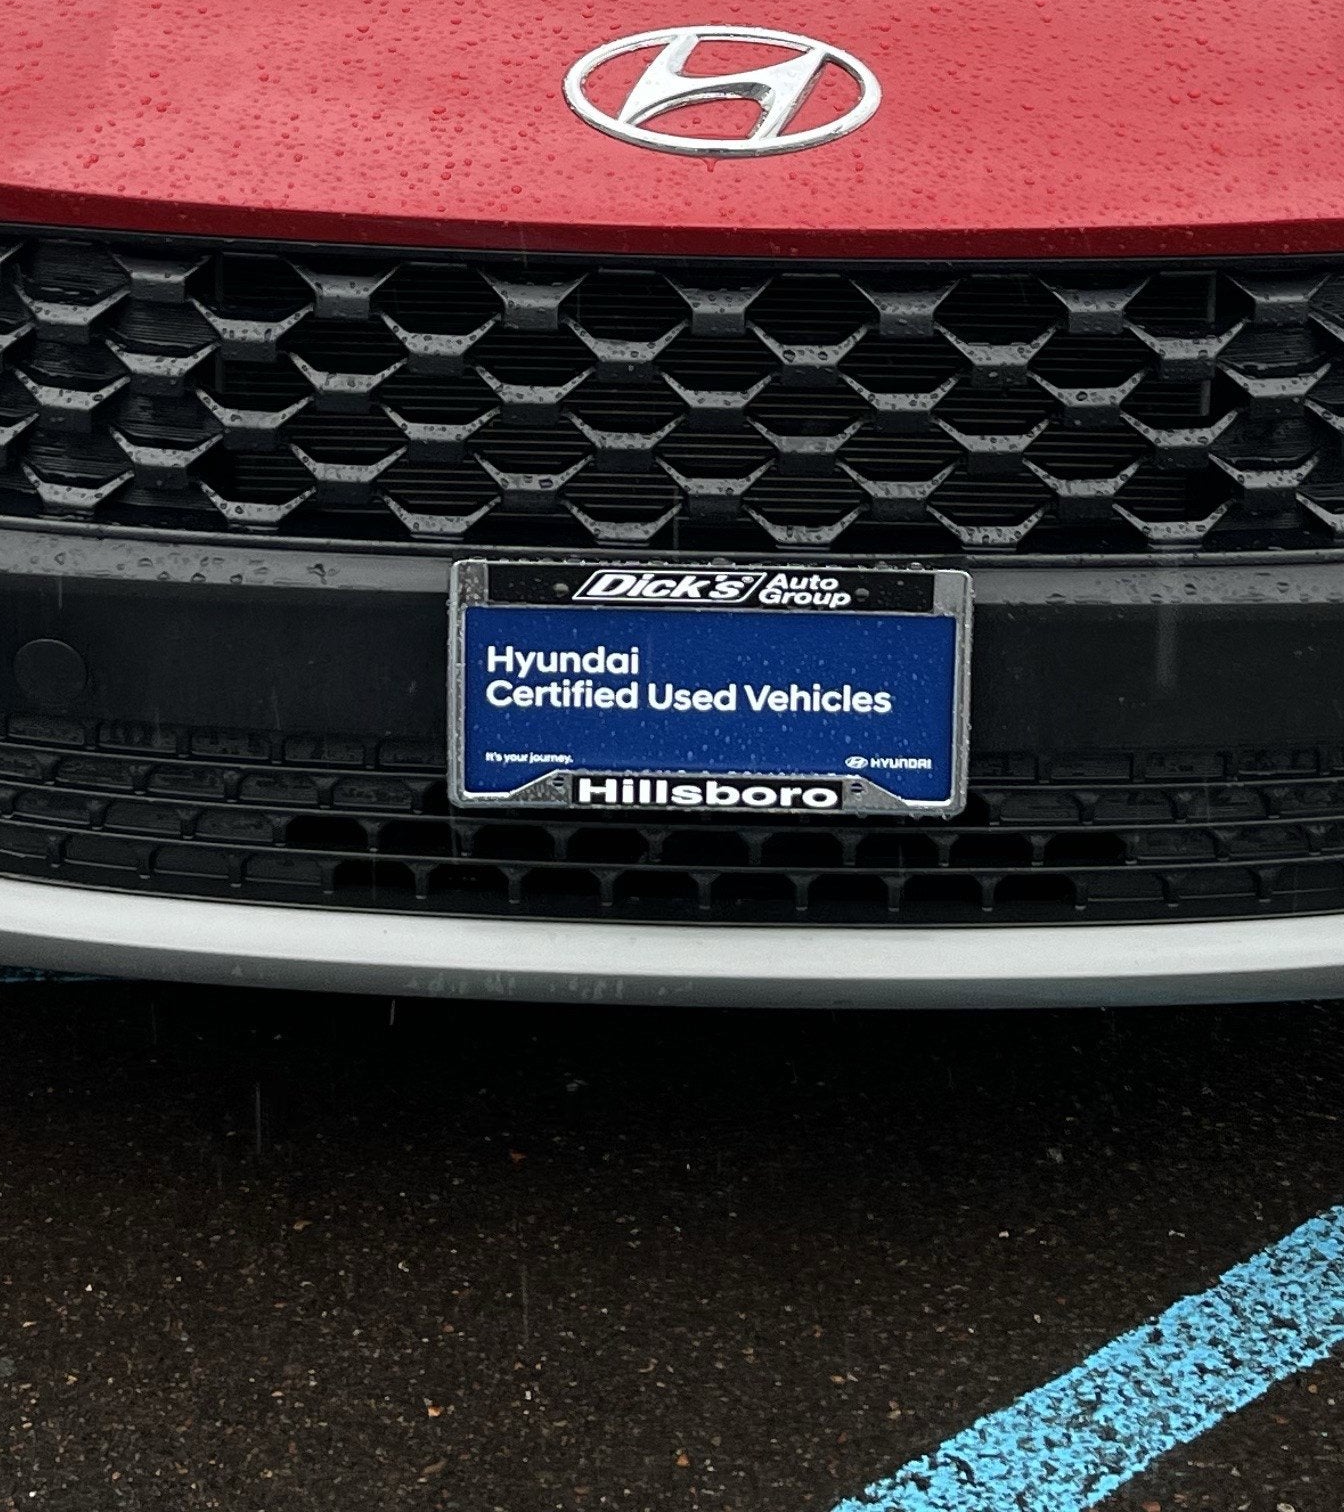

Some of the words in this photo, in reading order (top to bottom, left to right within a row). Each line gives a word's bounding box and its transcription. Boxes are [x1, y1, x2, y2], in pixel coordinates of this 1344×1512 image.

[767, 573, 839, 590] Auto
[758, 588, 851, 609] Group
[486, 646, 639, 678] Hyundai
[485, 679, 638, 709] Certified
[648, 684, 737, 712] Used
[744, 684, 892, 714] Vehicles
[485, 752, 503, 762] It's
[504, 753, 529, 764] your
[869, 757, 932, 769] HYUNDAI
[578, 777, 839, 808] Hillsboro
